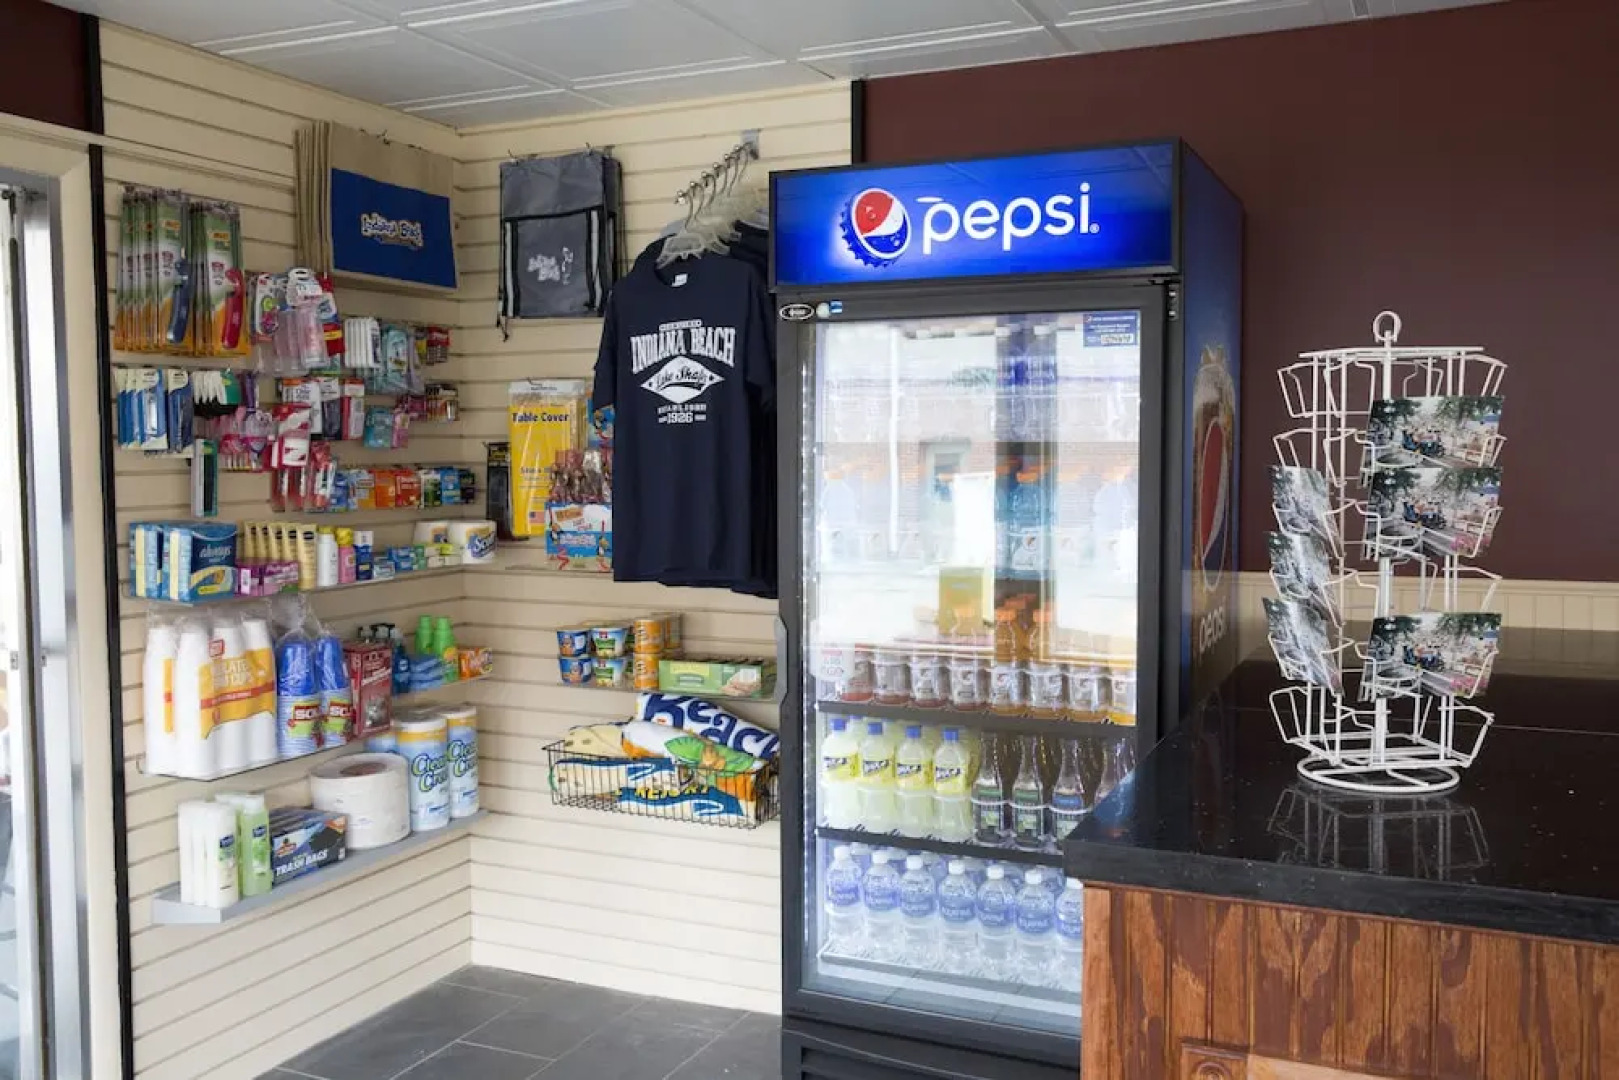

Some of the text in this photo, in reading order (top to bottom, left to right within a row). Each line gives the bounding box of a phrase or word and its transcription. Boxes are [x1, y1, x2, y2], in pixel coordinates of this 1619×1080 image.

[917, 182, 1092, 255] pepsi
[630, 327, 735, 374] INDIANA BEACH
[512, 412, 568, 423] Table Cover
[667, 413, 694, 424] 1926
[276, 856, 305, 876] TRASH
[306, 848, 328, 866] BAGS
